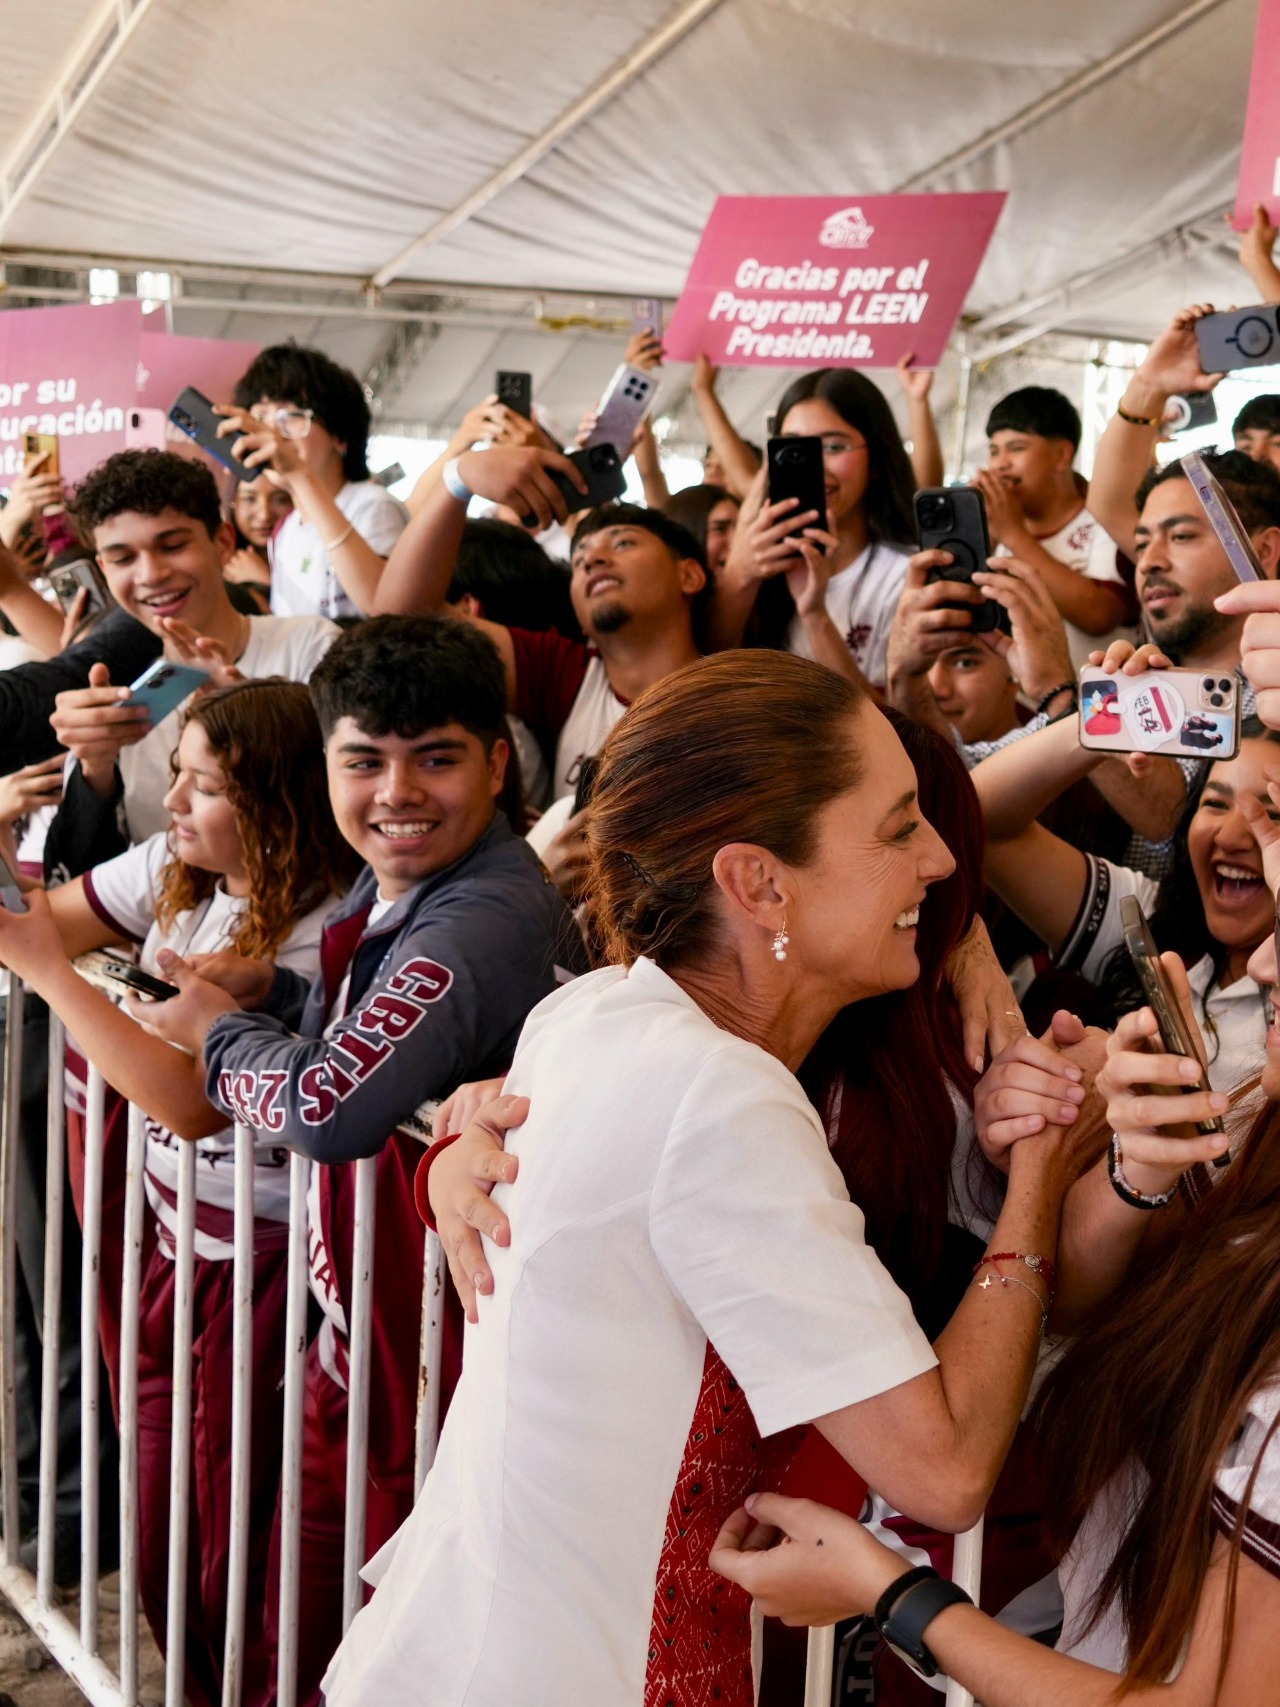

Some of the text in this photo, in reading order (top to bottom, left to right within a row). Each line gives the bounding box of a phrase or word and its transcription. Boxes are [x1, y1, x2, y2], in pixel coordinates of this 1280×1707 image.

[734, 258, 929, 298] Gracias por el
[708, 291, 929, 330] Programa LEEN
[725, 325, 875, 358] Presidenta.
[36, 378, 77, 405] su
[300, 956, 454, 1126] CBTIS
